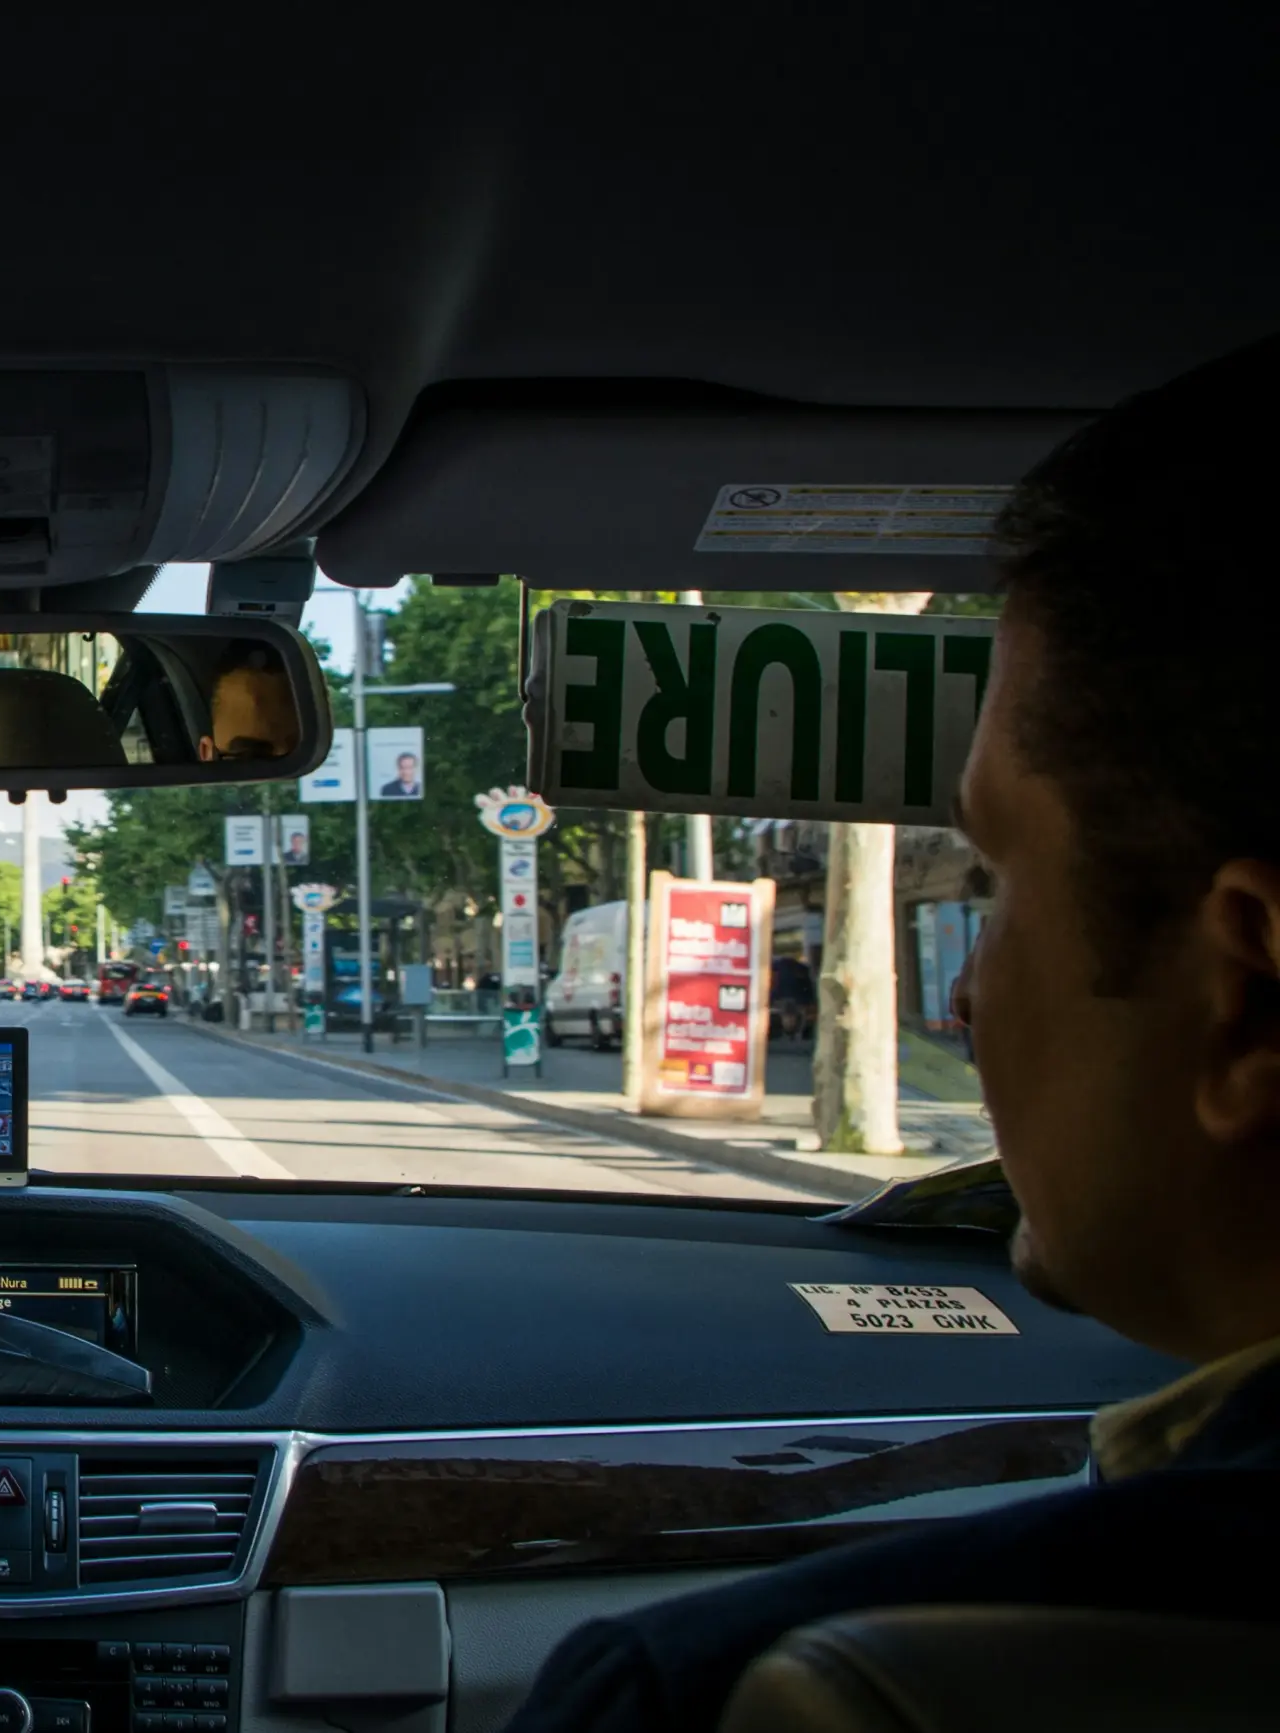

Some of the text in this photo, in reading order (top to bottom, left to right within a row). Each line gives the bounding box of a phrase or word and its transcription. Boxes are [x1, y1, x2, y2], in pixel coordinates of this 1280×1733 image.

[0, 1276, 27, 1289] Nura
[847, 1298, 966, 1310] 4 PLAZAS
[849, 1313, 999, 1330] 5023 GWK
